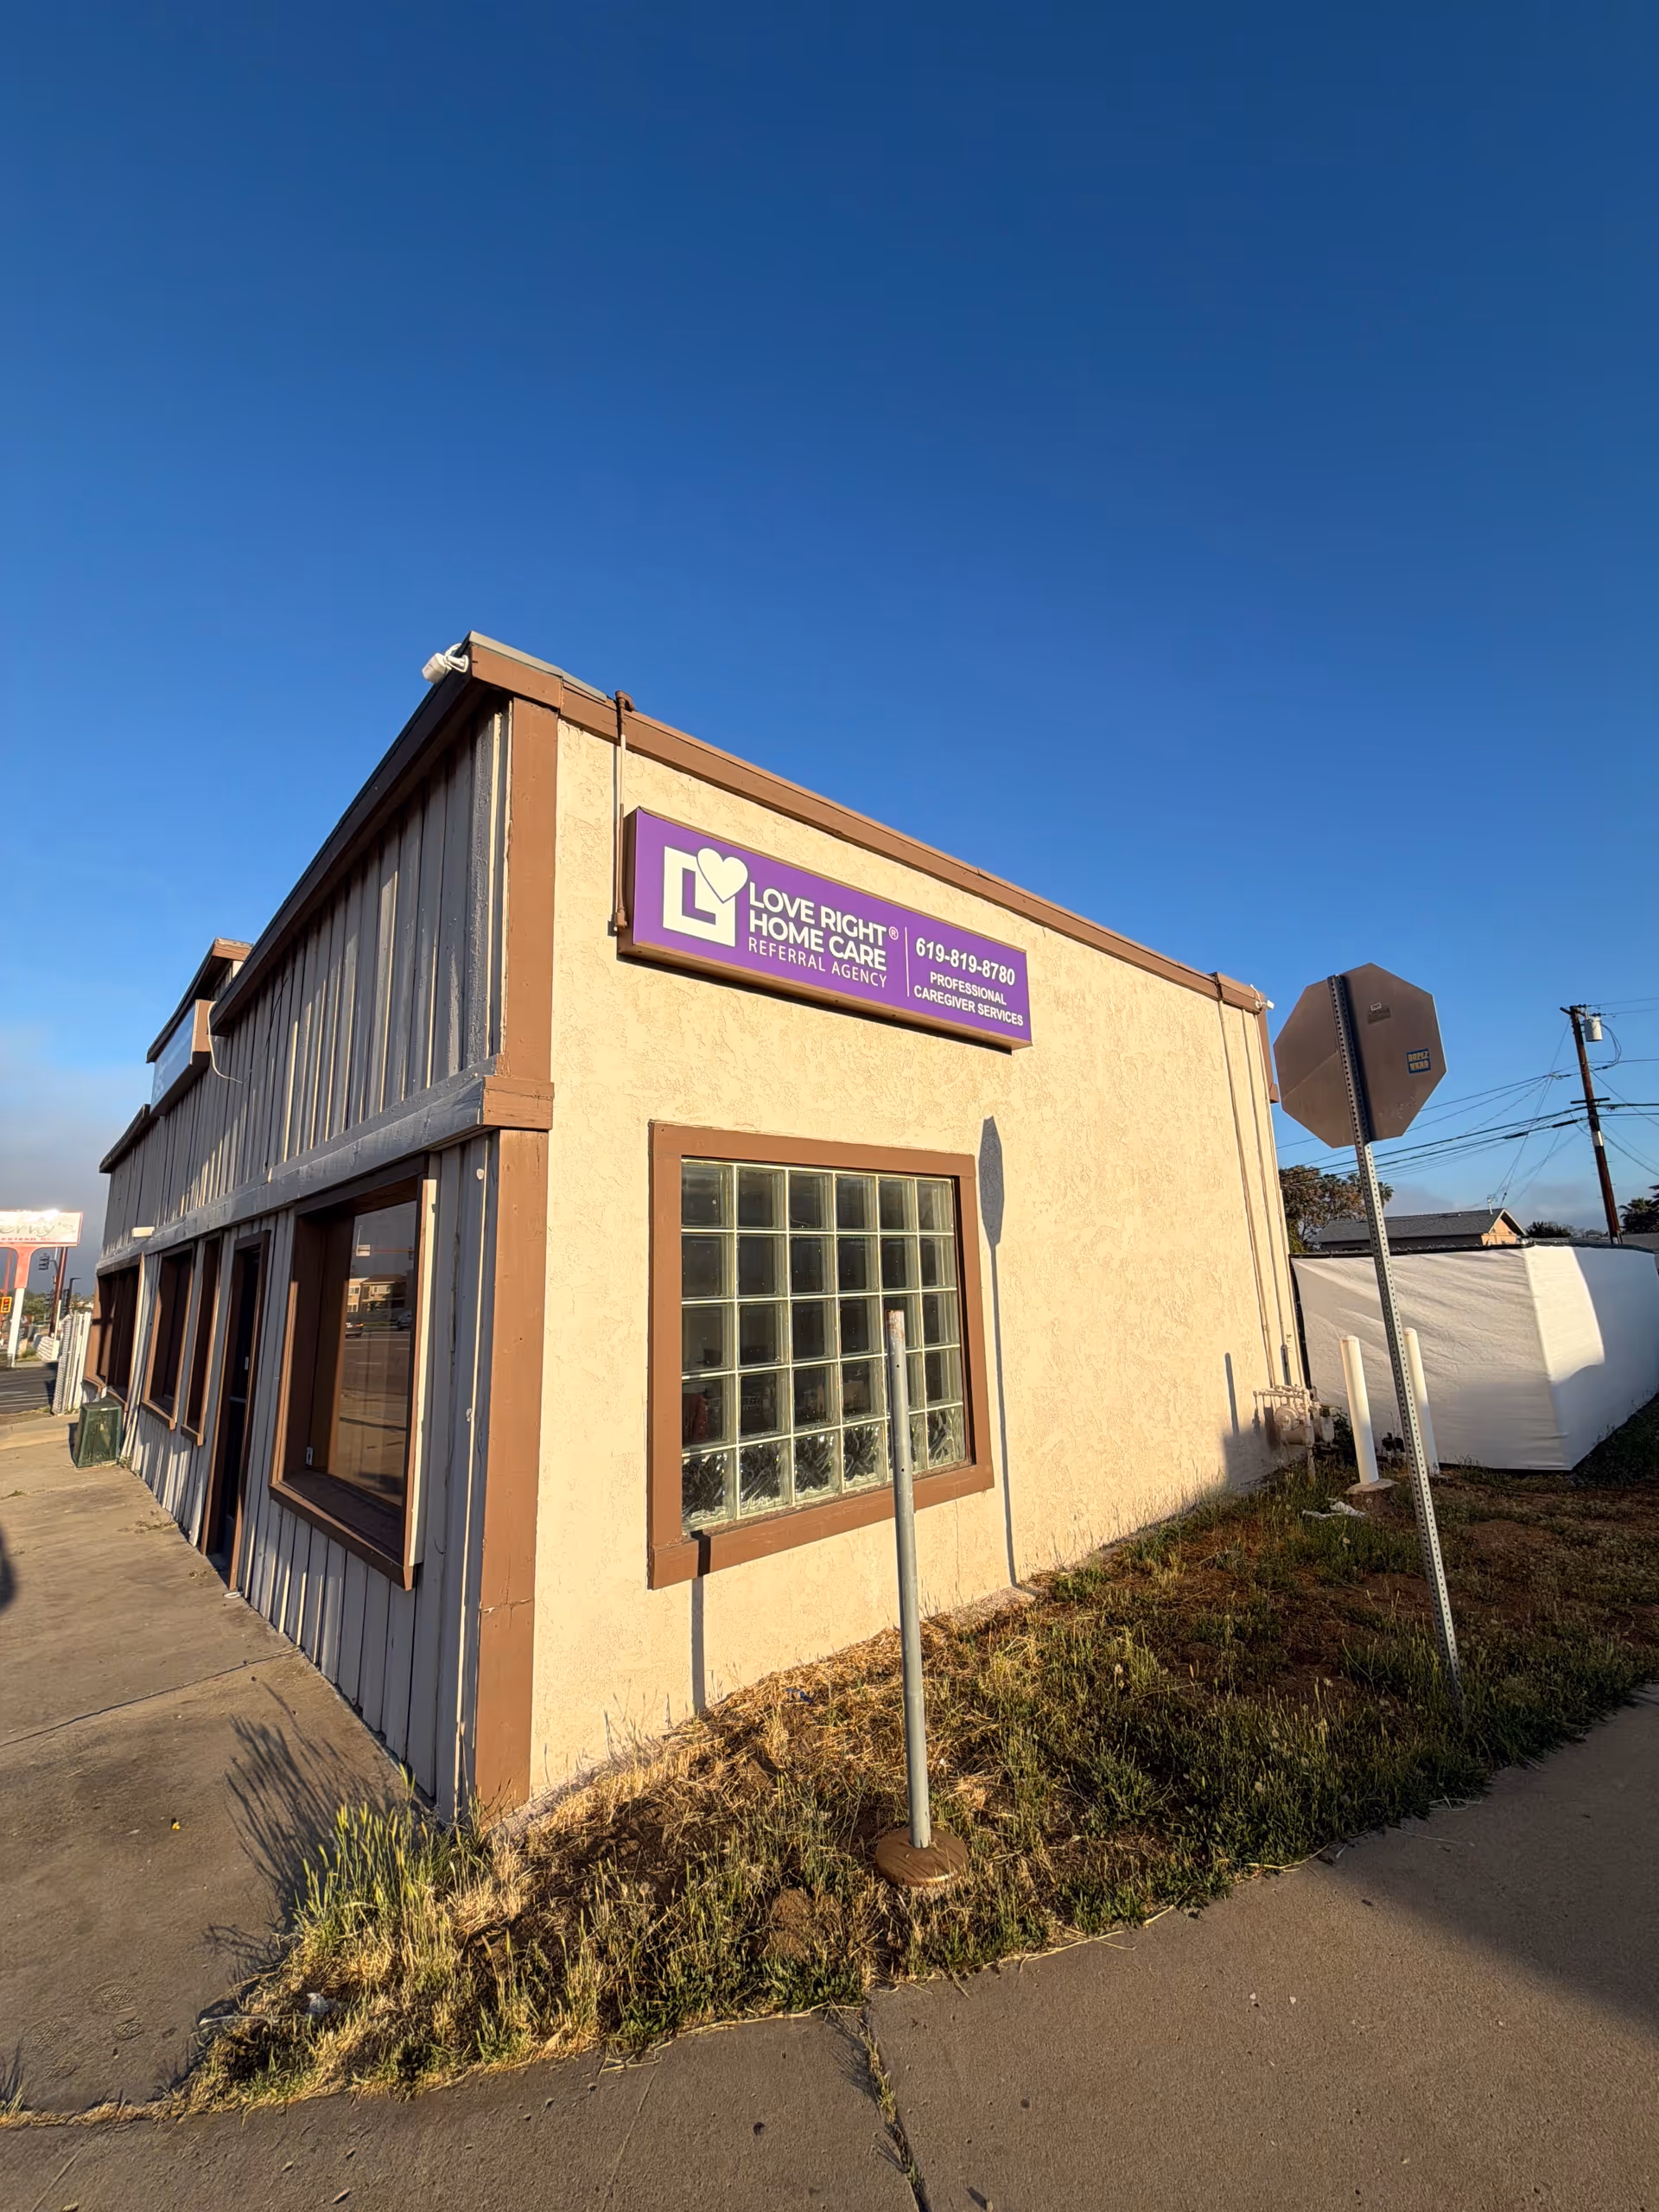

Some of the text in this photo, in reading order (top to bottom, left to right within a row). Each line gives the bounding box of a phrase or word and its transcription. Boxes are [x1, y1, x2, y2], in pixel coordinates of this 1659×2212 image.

[749, 881, 815, 925] LOVE
[748, 937, 887, 988] REFERRAL AGENCY
[749, 909, 887, 971] HOME CARE
[916, 937, 1015, 986] 619-819-8780
[913, 985, 1024, 1027] CAREGIVER SERVICES
[930, 971, 1007, 1006] PROFESSIONAL
